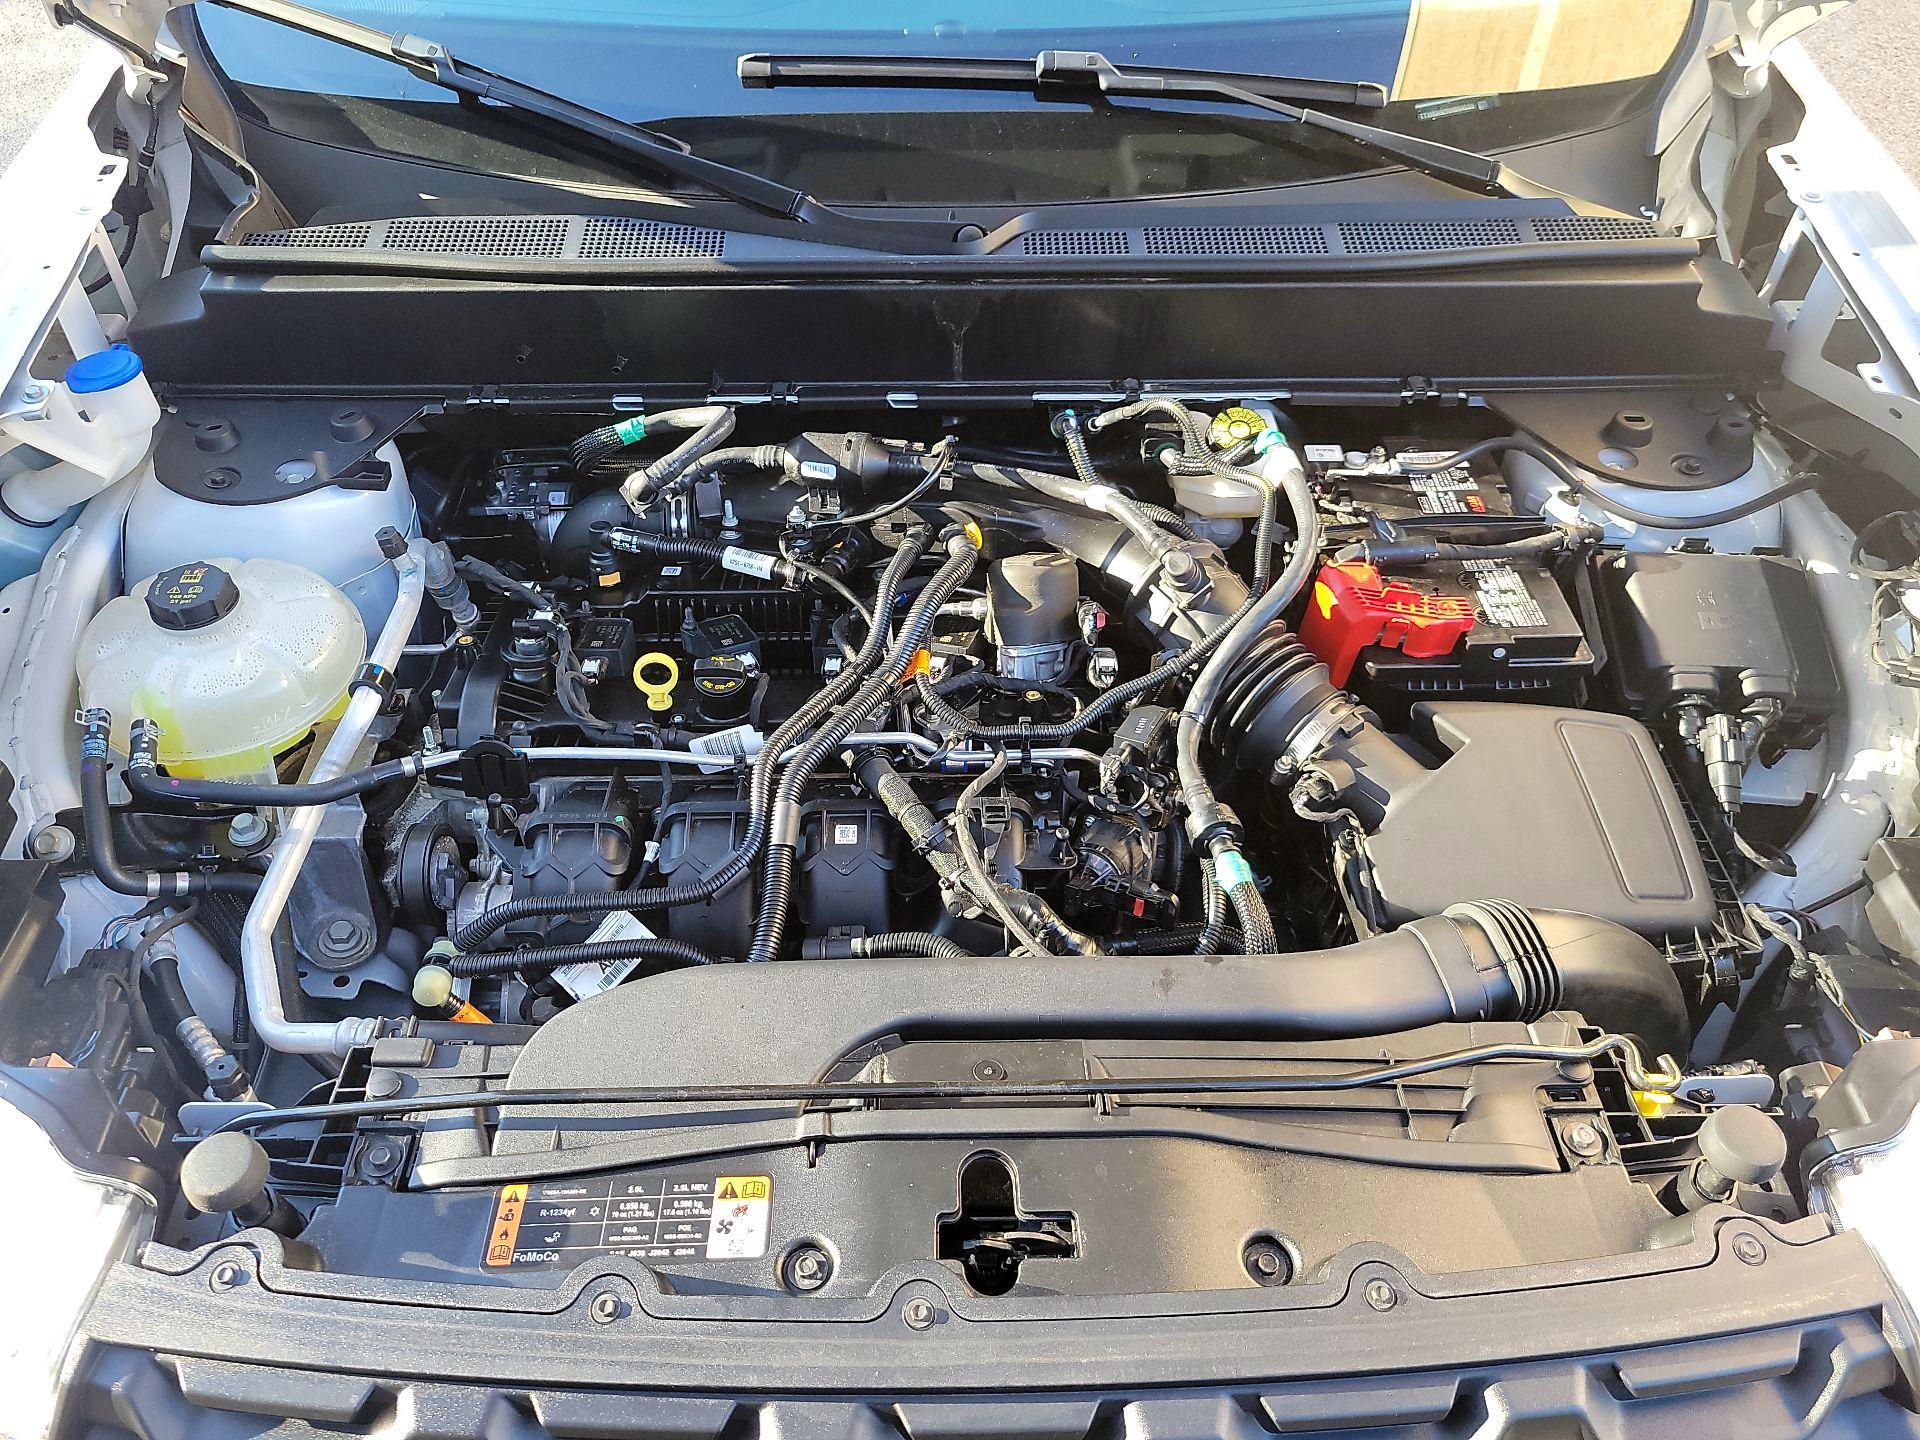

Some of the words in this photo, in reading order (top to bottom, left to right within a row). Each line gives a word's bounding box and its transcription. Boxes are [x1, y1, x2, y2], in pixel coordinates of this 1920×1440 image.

[673, 1184, 689, 1192] 2.5L
[691, 1183, 708, 1192] HEV
[640, 1201, 650, 1211] kg
[694, 1200, 703, 1210] kg
[540, 1207, 577, 1218] R-1234yf
[512, 1251, 560, 1262] FoMoCo
